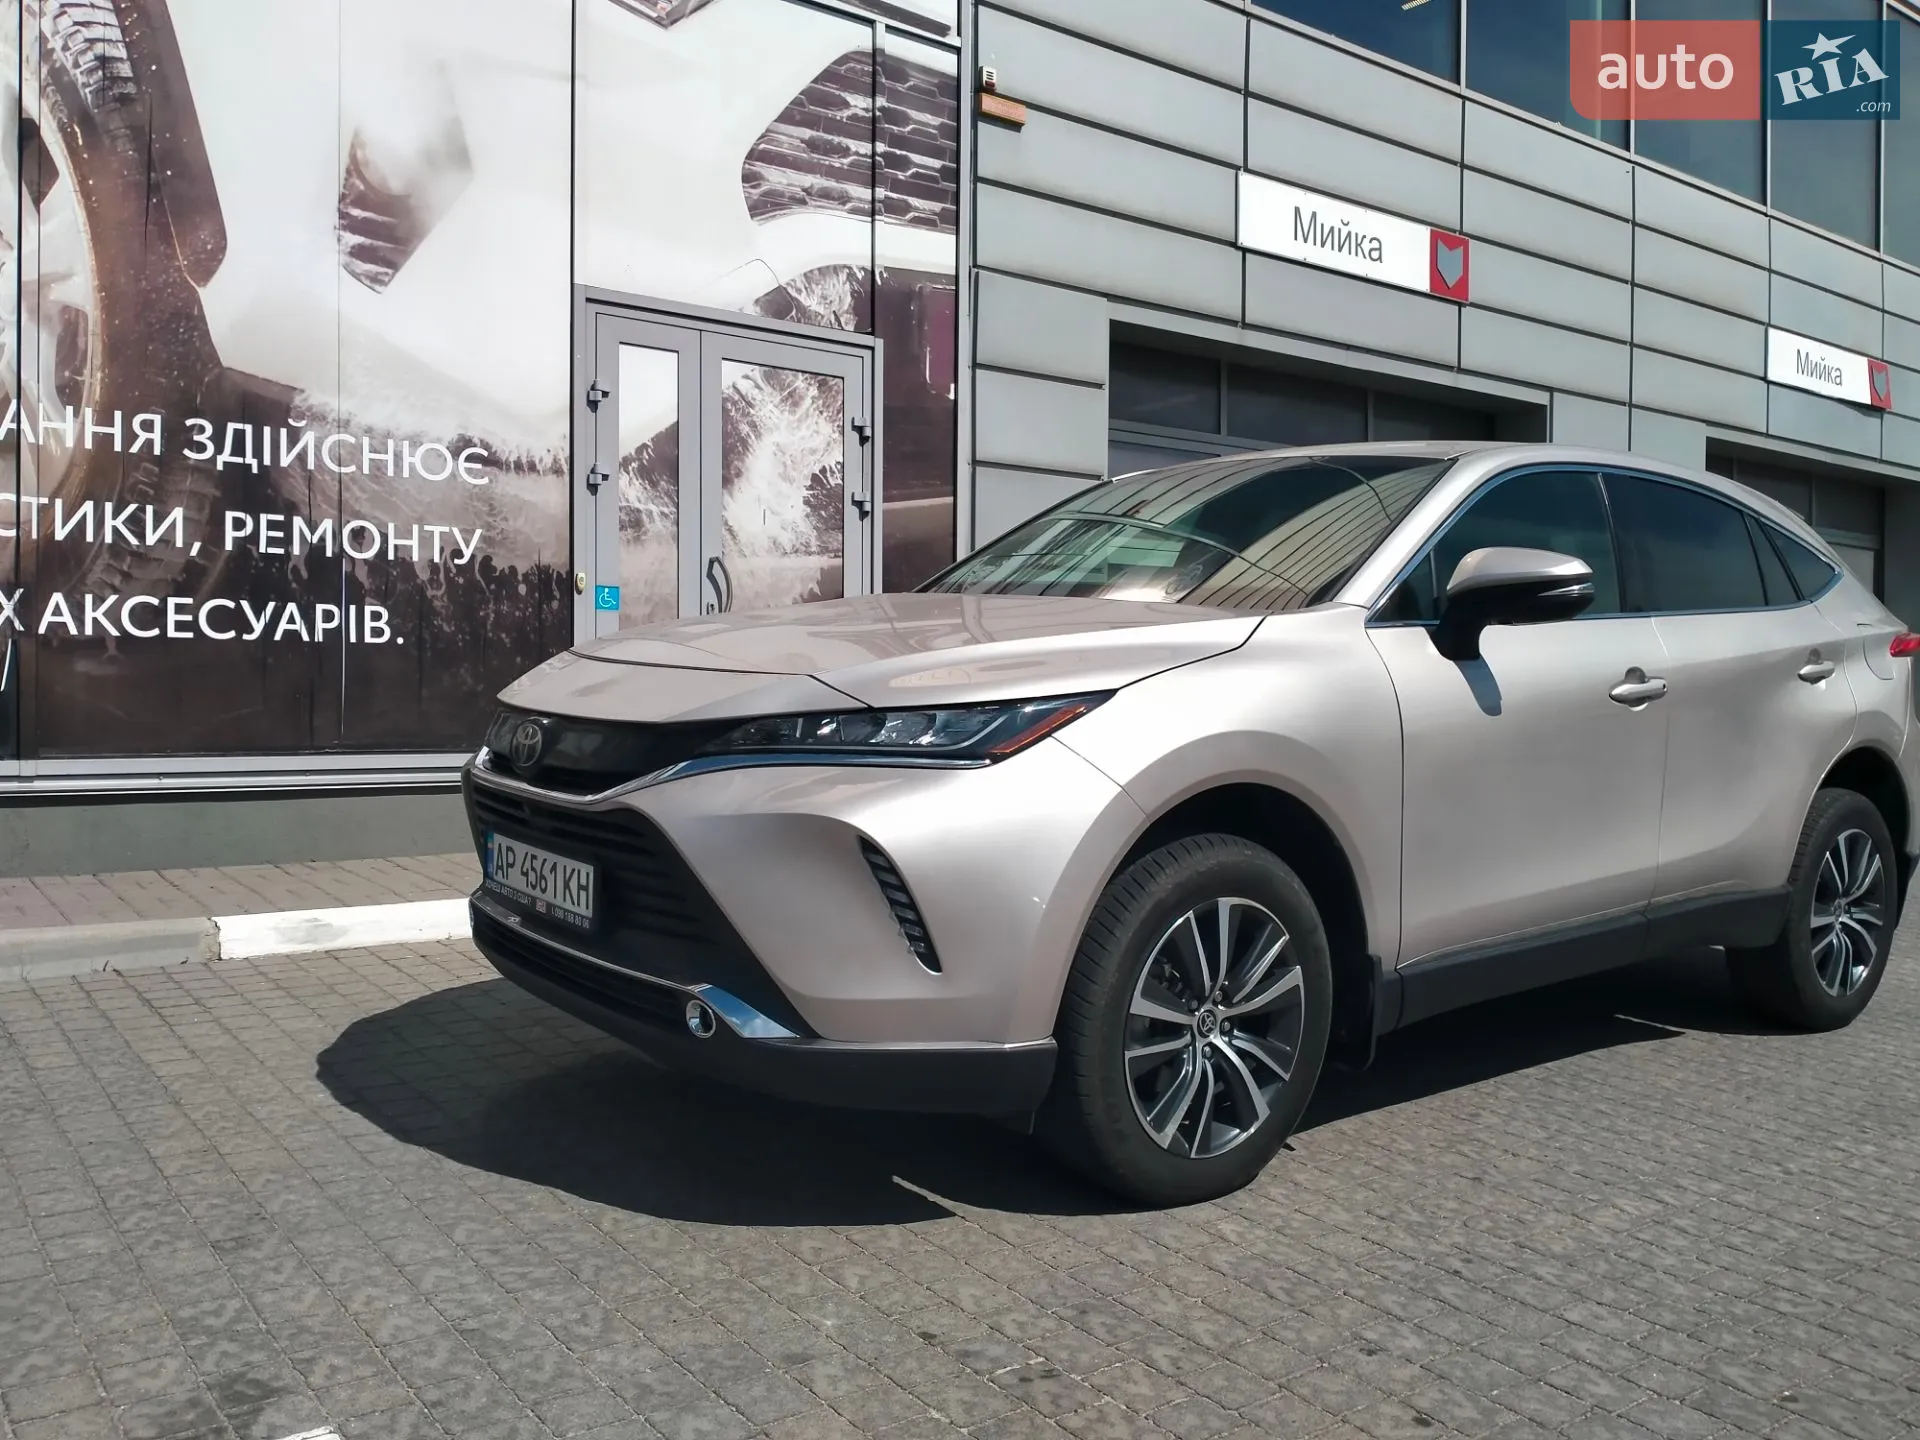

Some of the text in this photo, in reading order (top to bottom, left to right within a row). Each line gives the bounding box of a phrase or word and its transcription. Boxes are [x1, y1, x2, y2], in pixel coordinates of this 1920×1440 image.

[1293, 205, 1384, 264] Мийка
[1796, 348, 1843, 387] Мийка
[0, 398, 489, 485] АННЯ ЗДІЙСНЮЄ
[224, 510, 483, 565] РЕМОНТУ
[37, 591, 405, 645] АКСЕСУАРІВ.
[520, 851, 558, 900] 4561
